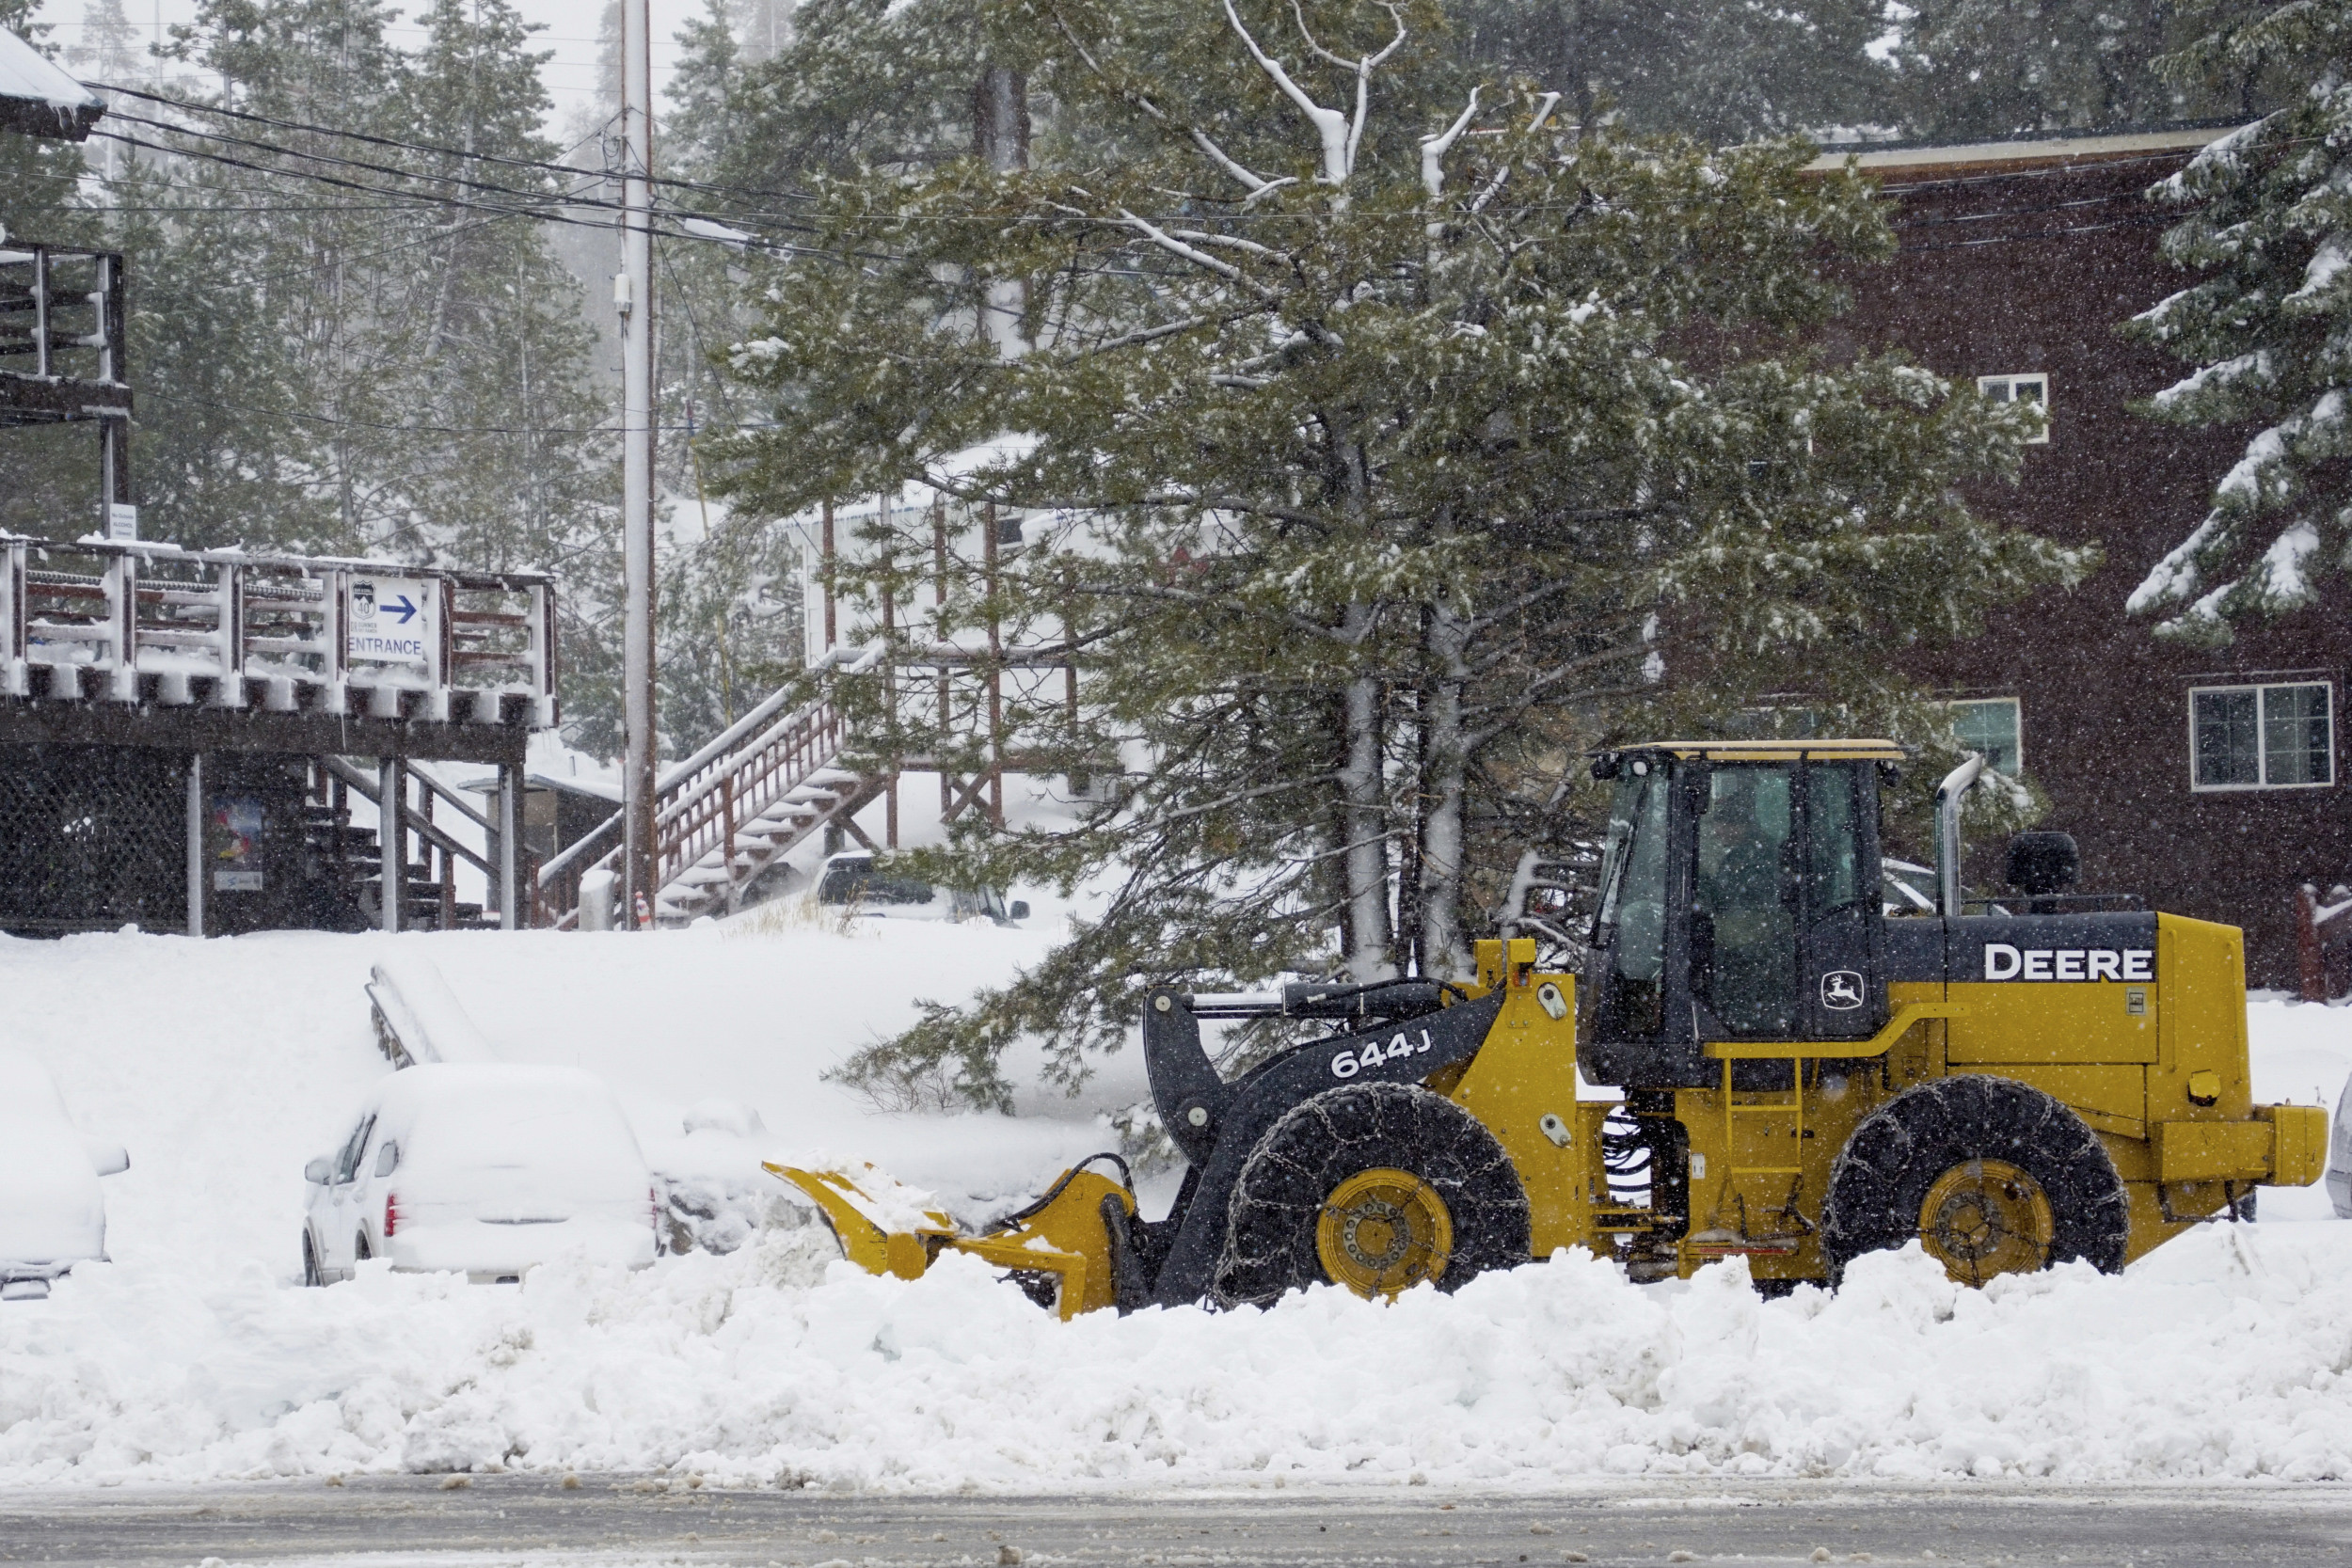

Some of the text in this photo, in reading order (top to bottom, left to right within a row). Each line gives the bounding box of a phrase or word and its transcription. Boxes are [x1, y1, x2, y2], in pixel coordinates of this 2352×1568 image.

[358, 602, 369, 614] 40
[348, 637, 421, 656] ENTRANCE
[1985, 943, 2153, 980] DEERE
[1331, 1029, 1431, 1078] 644J
